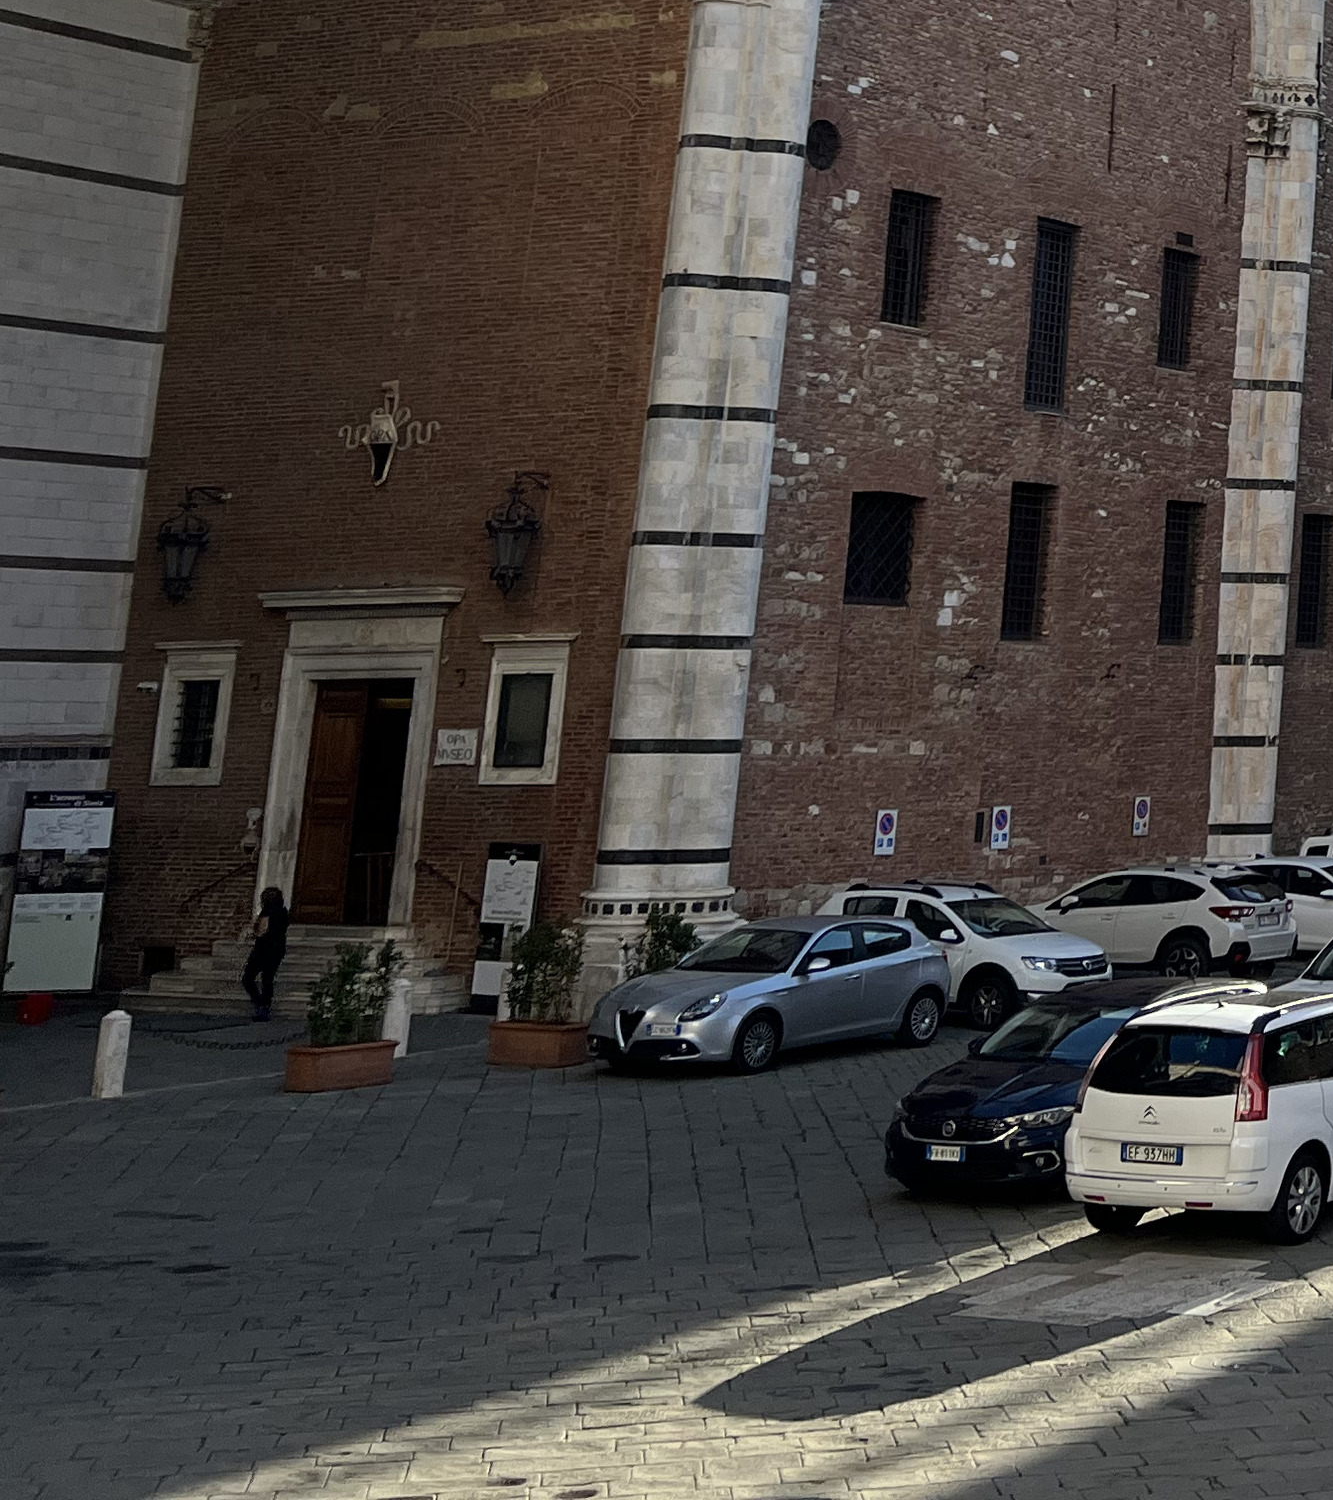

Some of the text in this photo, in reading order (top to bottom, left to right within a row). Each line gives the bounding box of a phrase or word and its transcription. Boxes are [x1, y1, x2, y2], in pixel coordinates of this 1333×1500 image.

[446, 733, 466, 745] OPA
[1128, 1145, 1176, 1162] EF 937HH
